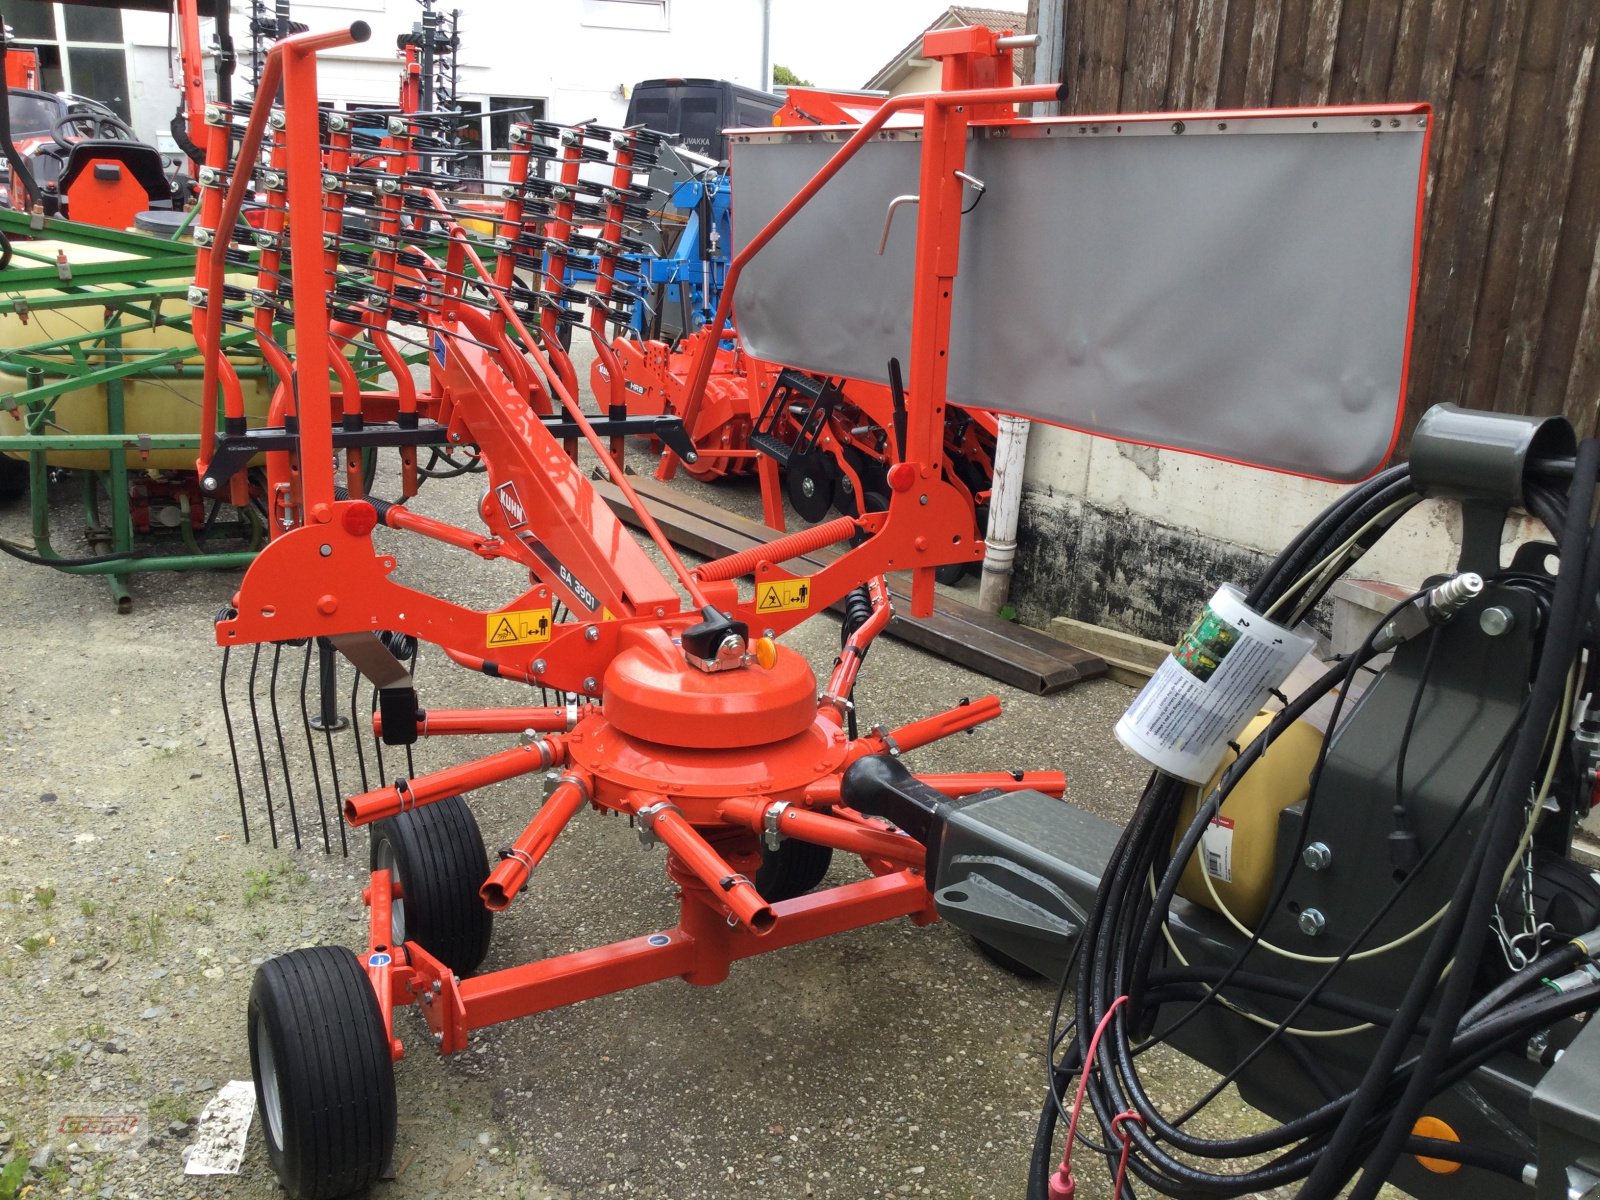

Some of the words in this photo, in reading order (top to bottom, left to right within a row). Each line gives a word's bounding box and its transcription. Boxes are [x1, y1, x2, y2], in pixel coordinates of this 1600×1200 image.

[500, 488, 523, 523] KUHN
[560, 565, 572, 587] GA
[574, 580, 595, 609] 3901
